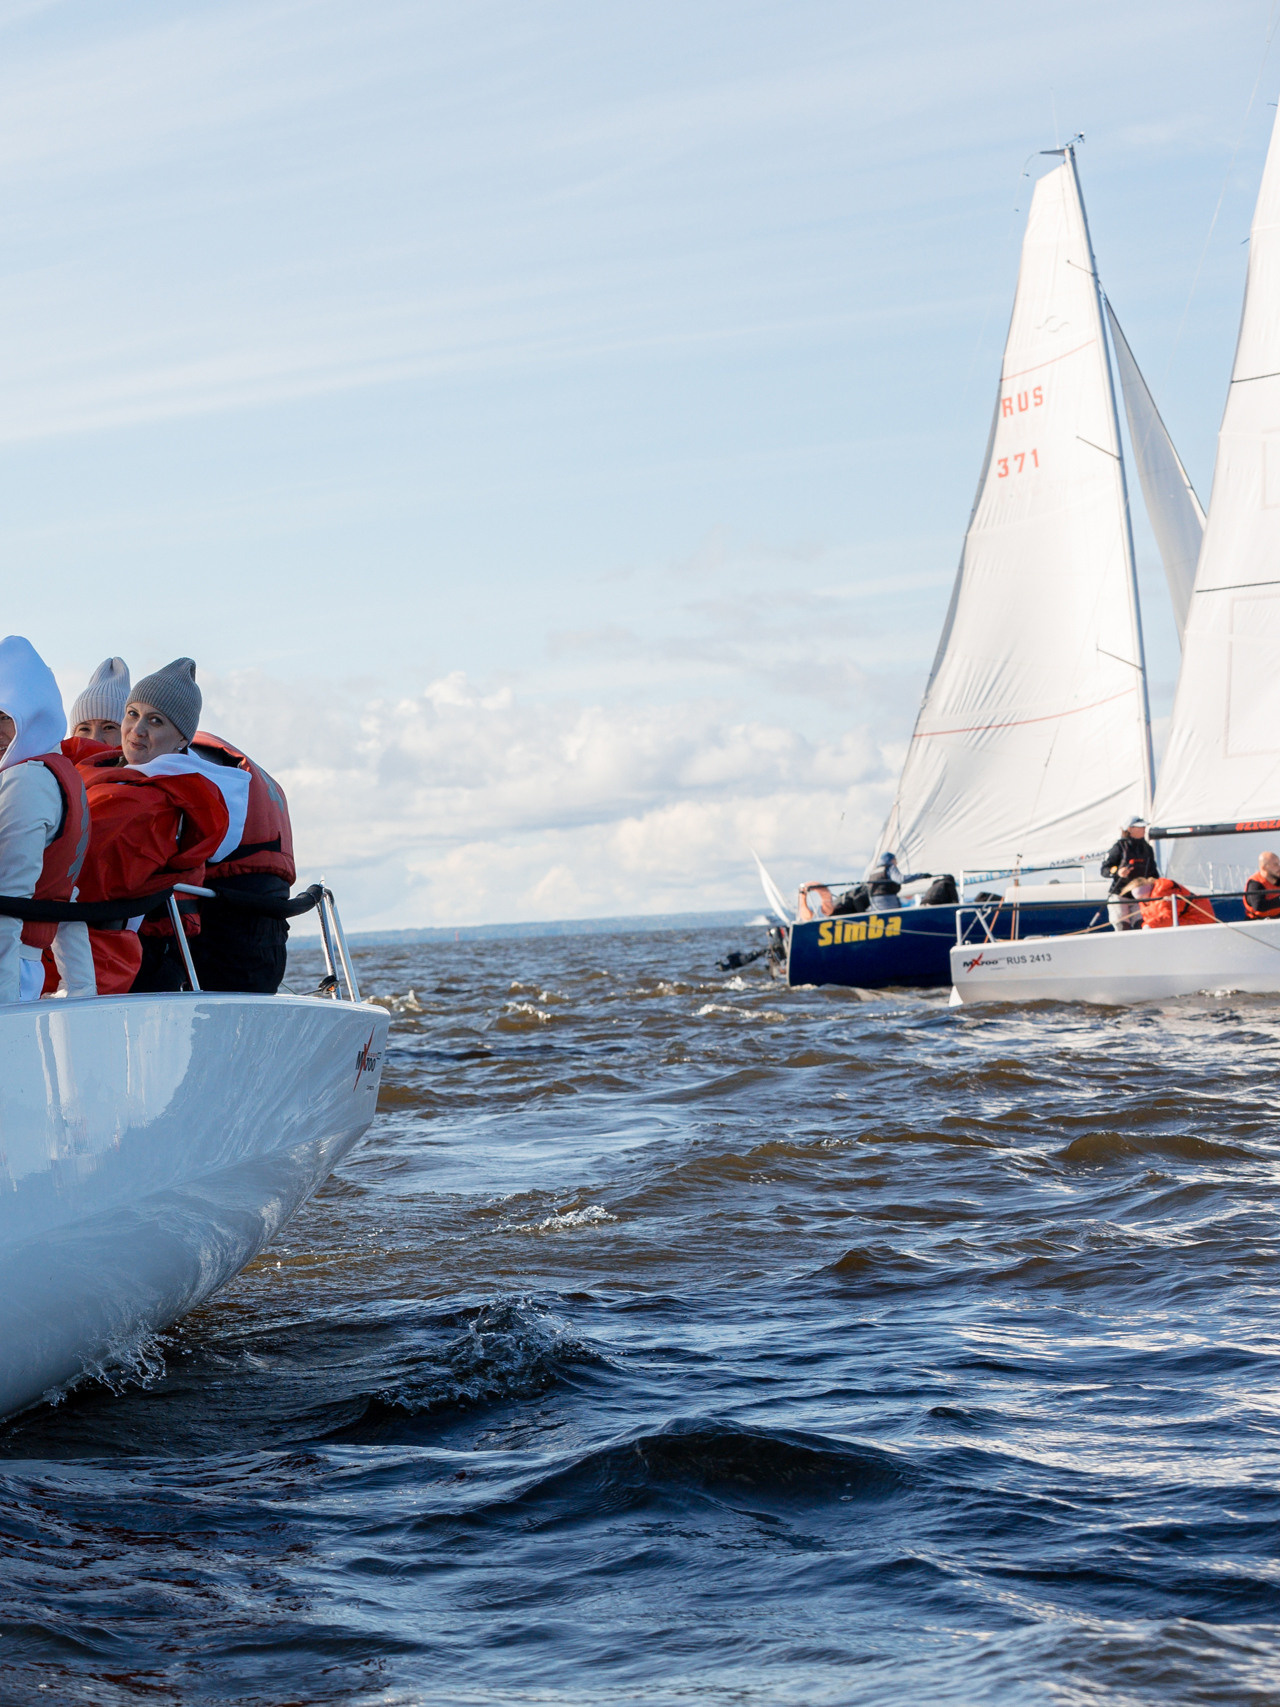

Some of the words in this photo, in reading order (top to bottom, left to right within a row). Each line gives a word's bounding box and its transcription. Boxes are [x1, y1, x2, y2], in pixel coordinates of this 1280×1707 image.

[1001, 385, 1044, 418] RUS
[996, 448, 1040, 479] 371
[817, 915, 902, 947] Simba
[1006, 955, 1028, 966] RUS
[1029, 953, 1052, 964] 2413
